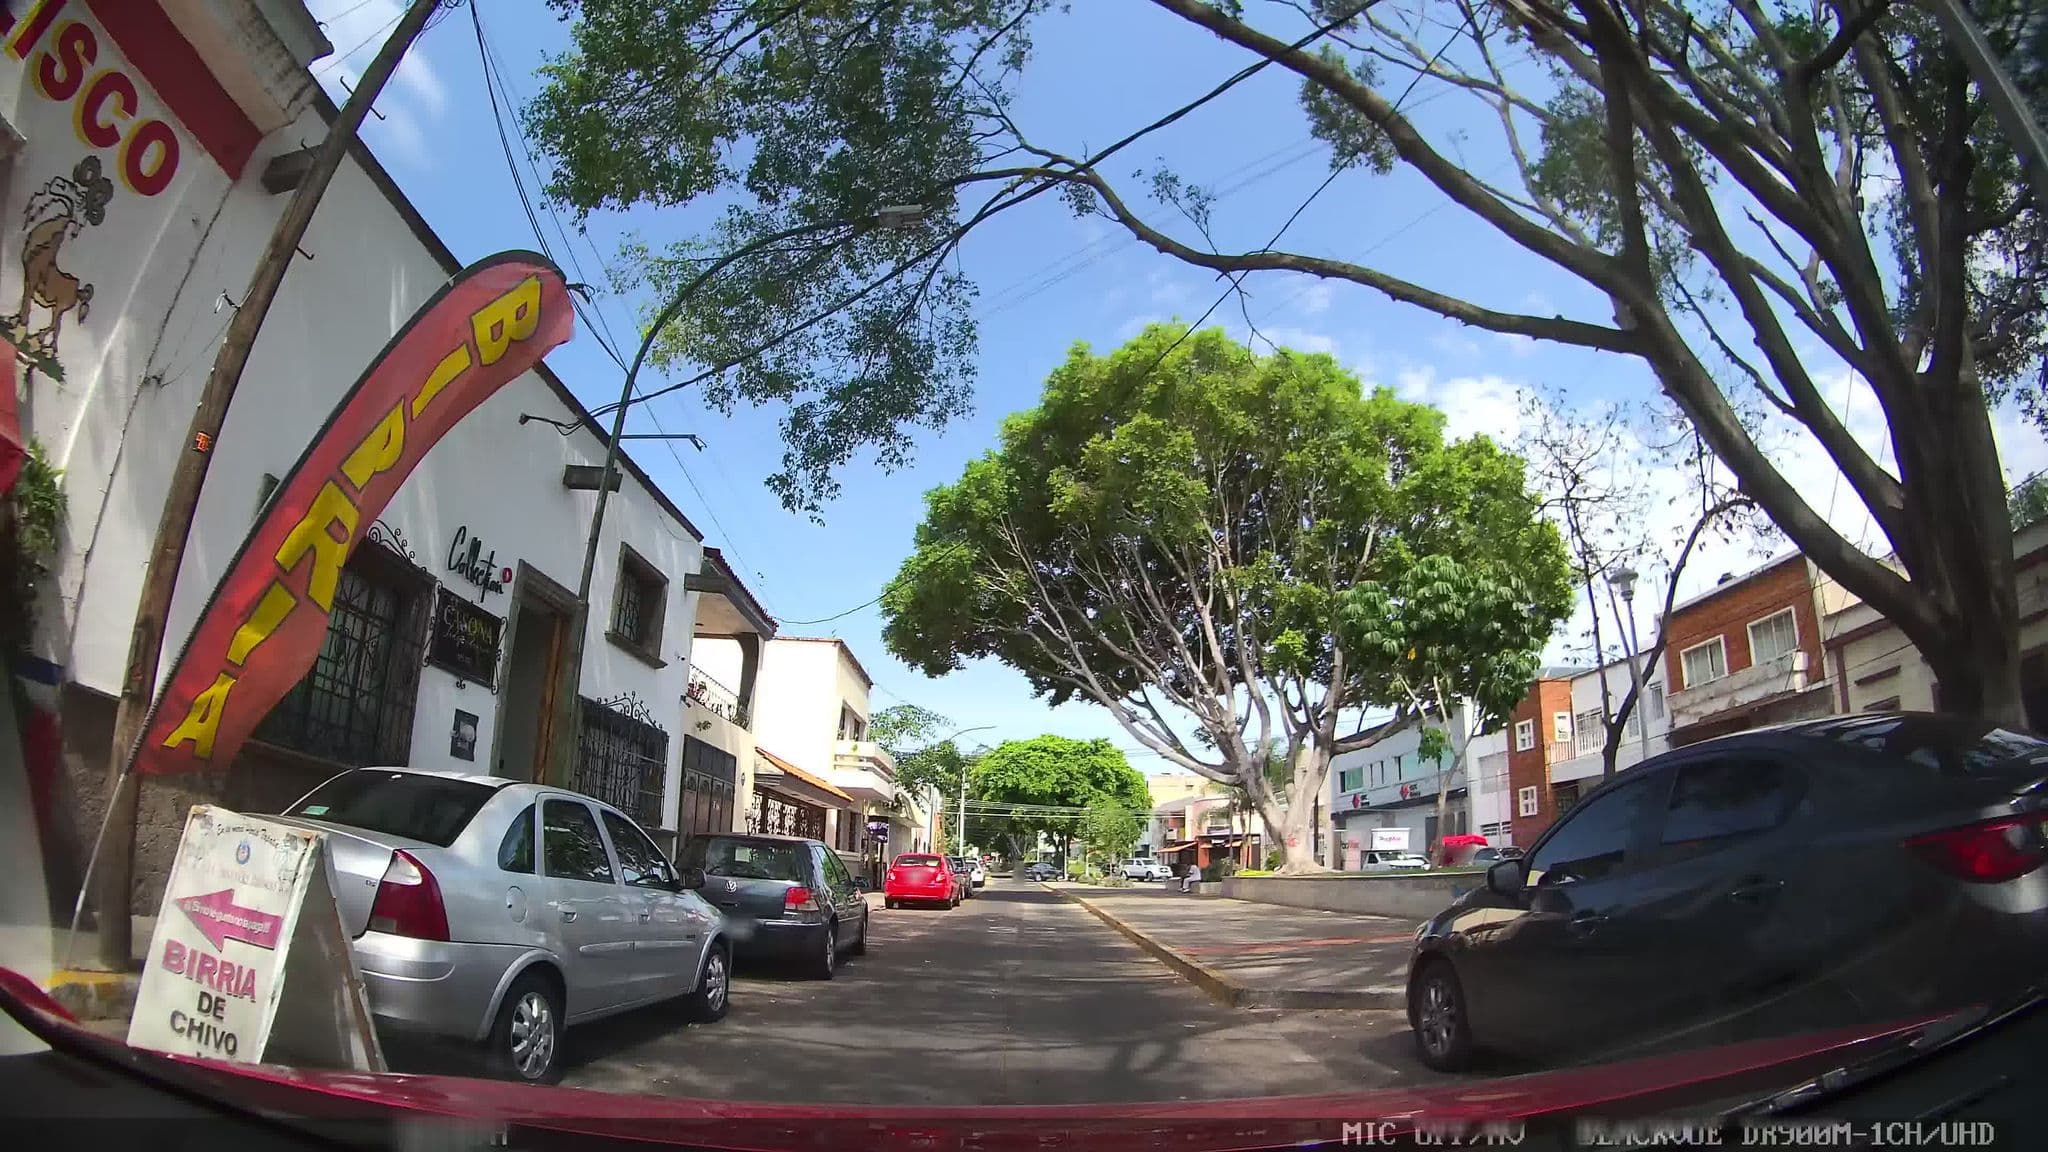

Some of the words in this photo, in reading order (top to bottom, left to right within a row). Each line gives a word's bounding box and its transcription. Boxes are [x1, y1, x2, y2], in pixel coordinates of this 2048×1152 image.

[0, 0, 180, 197] ISCO
[161, 273, 543, 761] BIRRIA
[447, 525, 504, 603] Collection
[160, 938, 257, 1003] BIRRIA
[196, 990, 228, 1022] DE
[170, 1010, 238, 1055] CHIVO
